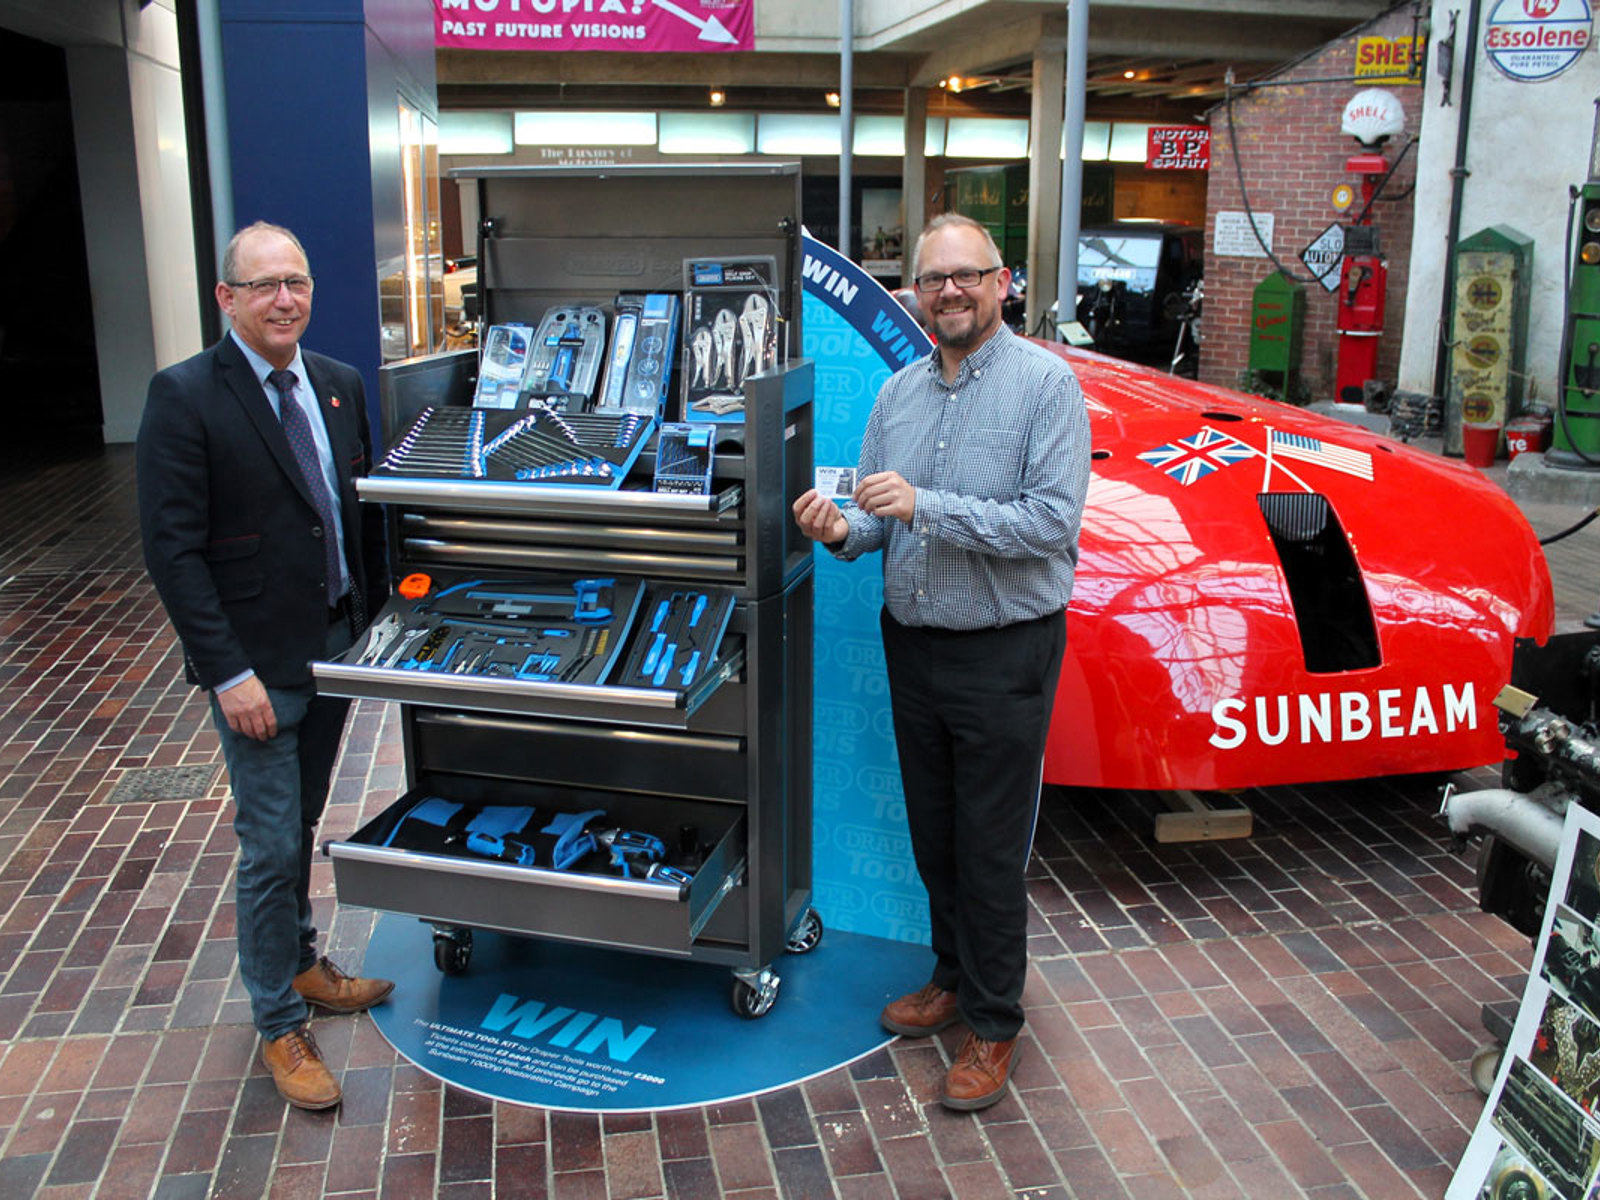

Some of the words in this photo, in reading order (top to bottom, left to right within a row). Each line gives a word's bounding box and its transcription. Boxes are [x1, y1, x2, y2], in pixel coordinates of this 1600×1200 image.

[442, 20, 487, 36] PAST
[495, 23, 563, 38] FUTURE
[571, 24, 646, 39] VISIONS
[1487, 26, 1588, 48] Essolene
[1360, 43, 1424, 65] SHE
[1349, 106, 1388, 121] SHELL
[1153, 129, 1208, 140] MOTOR
[541, 148, 564, 158] The
[1152, 158, 1208, 168] SPIRIT
[803, 253, 859, 307] WIN
[803, 328, 873, 358] ools
[871, 309, 921, 367] WIN
[1509, 439, 1527, 452] re
[1208, 682, 1478, 750] SUNBEAM
[480, 993, 656, 1062] WIN
[429, 1022, 475, 1039] ULTIMATE
[475, 1034, 500, 1045] TOOL
[500, 1040, 520, 1049] KIT
[530, 1046, 560, 1060] Draper
[562, 1054, 585, 1066] Tools
[585, 1061, 612, 1072] worth
[612, 1067, 634, 1077] over
[531, 1058, 550, 1068] and
[549, 1062, 567, 1072] can
[578, 1070, 629, 1087] purchased
[553, 1080, 600, 1097] Campaign
[590, 1079, 602, 1088] to
[601, 1081, 618, 1092] the
